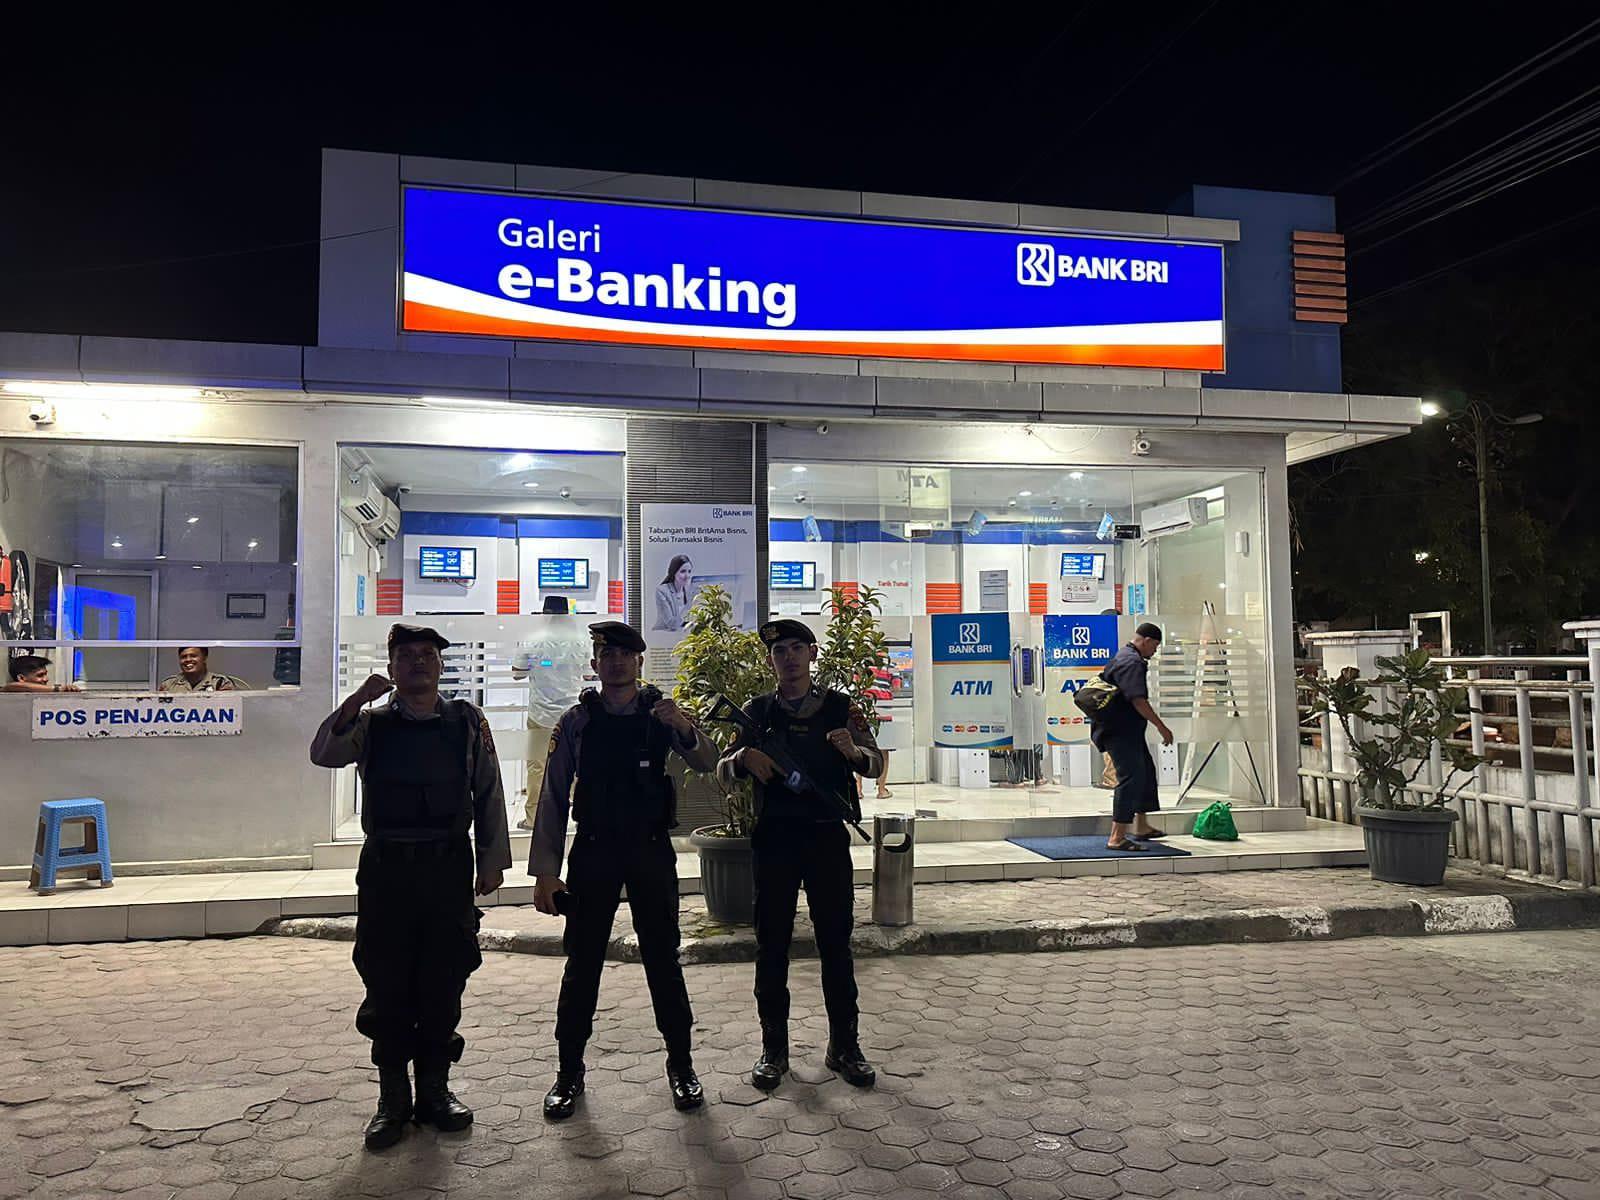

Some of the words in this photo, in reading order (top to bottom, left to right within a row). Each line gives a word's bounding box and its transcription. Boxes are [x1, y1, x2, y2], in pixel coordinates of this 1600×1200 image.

[498, 218, 601, 253] Galeri
[1058, 255, 1127, 281] BANK
[1131, 260, 1169, 284] BRI
[497, 257, 797, 328] e-Banking
[648, 527, 684, 536] Tabungan
[948, 644, 975, 654] BANK
[977, 644, 993, 654] BRI
[1053, 648, 1088, 659] BANK
[1090, 648, 1110, 659] BRI
[950, 680, 993, 695] ATM
[40, 709, 87, 725] POS
[95, 708, 235, 725] PENJAGAAN
